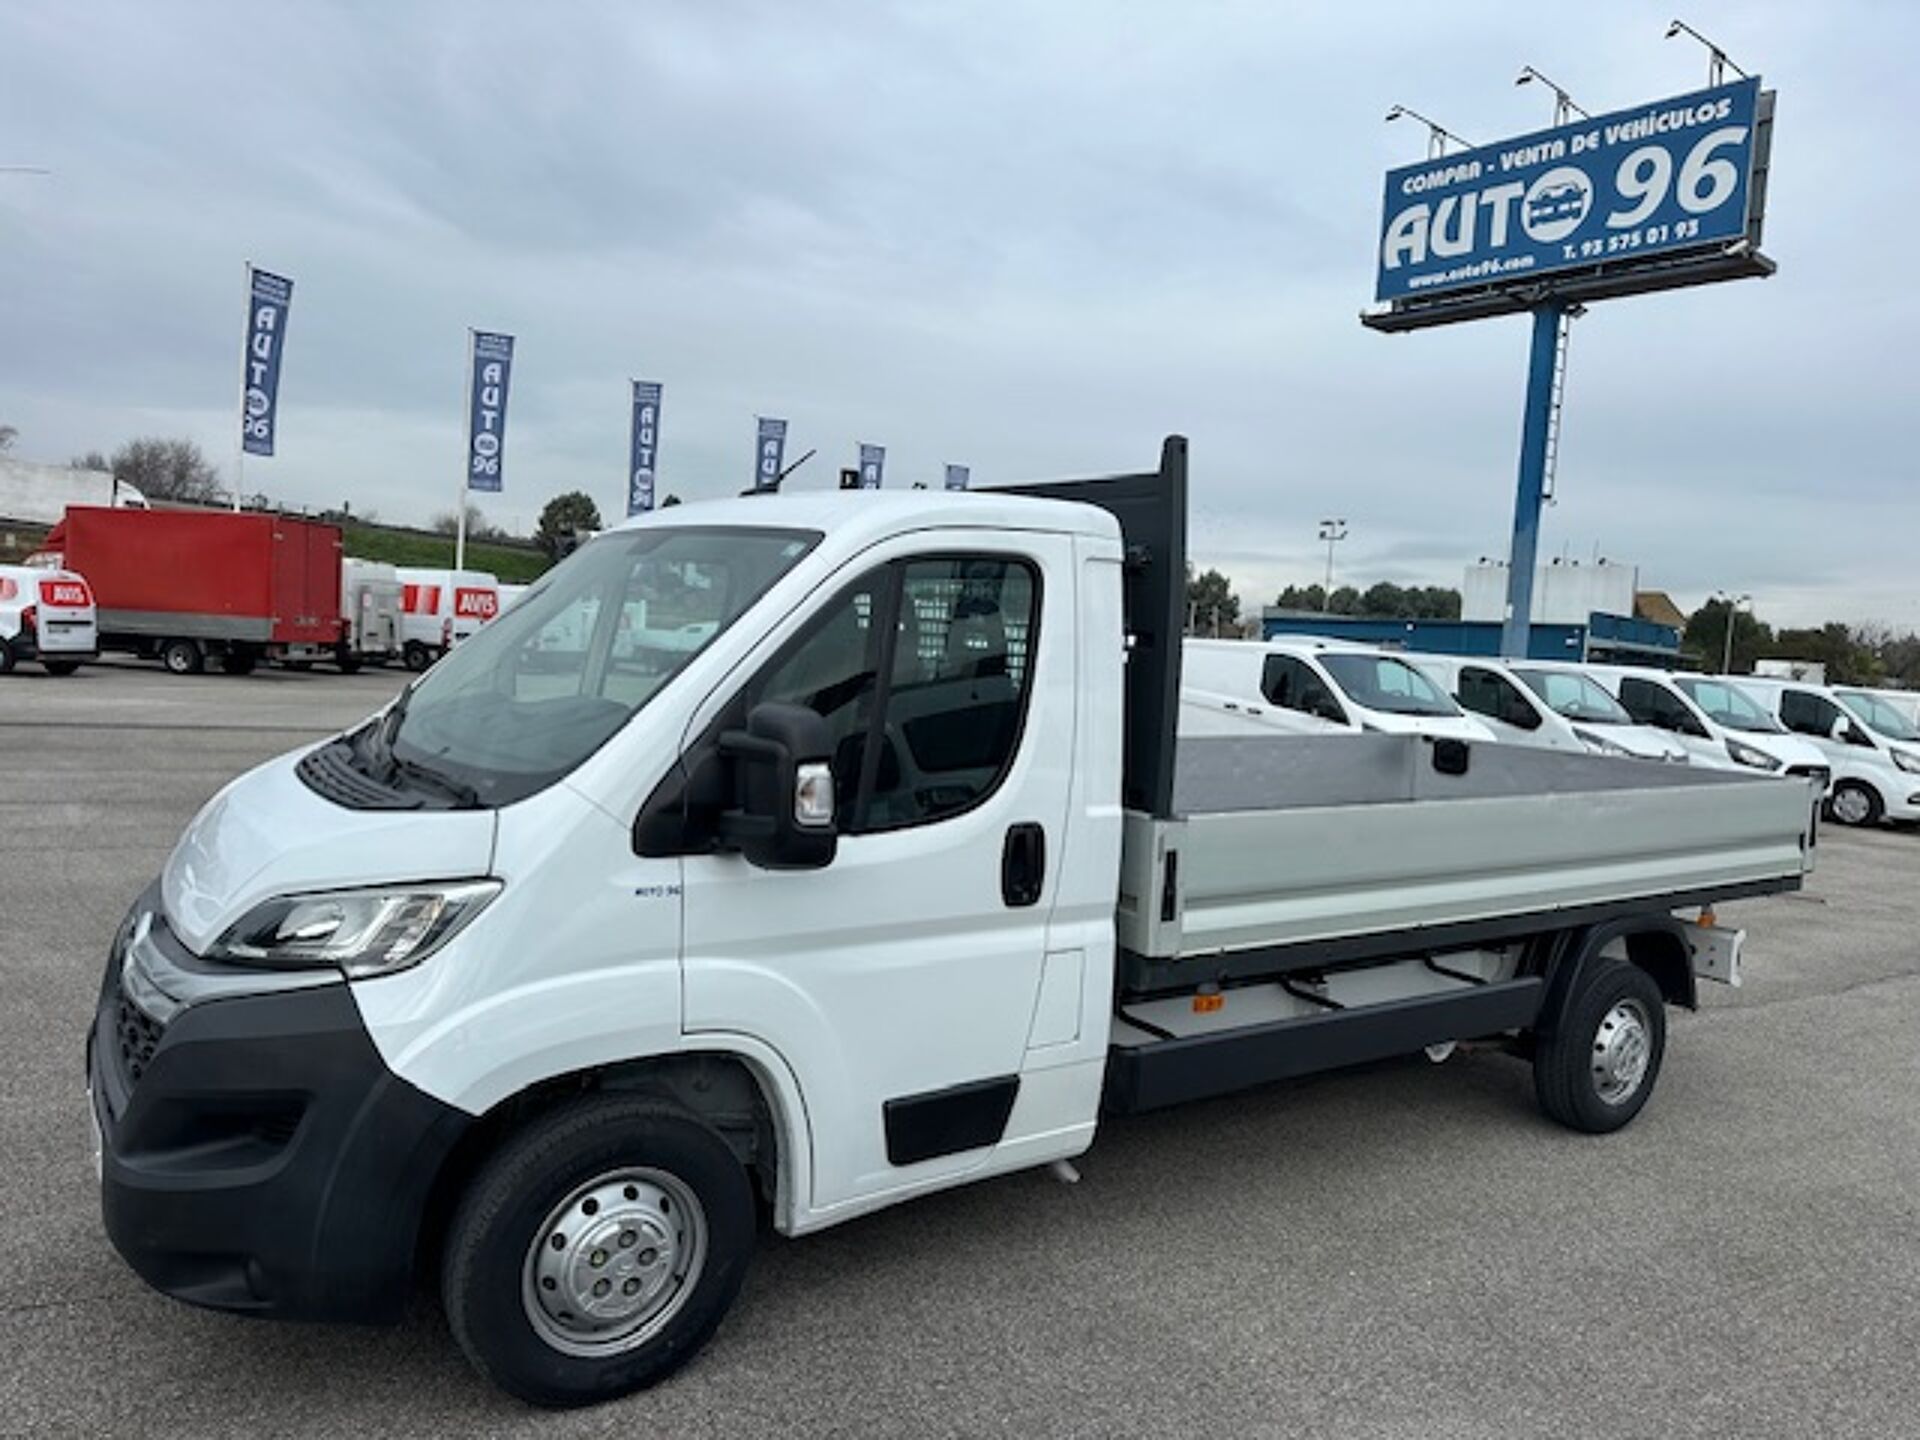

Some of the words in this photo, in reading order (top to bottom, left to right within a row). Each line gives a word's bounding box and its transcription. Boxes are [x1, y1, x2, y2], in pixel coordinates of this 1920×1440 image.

[1402, 161, 1482, 195] COMPRA
[1501, 139, 1566, 172] VENTA
[1571, 131, 1600, 154] DE
[1604, 98, 1733, 145] VEHÍCULOS
[1384, 167, 1594, 269] AUTO
[1605, 126, 1749, 229] 96
[1581, 240, 1603, 256] 93
[1608, 230, 1641, 252] 575
[1646, 224, 1669, 244] 01
[1674, 219, 1699, 239] 93
[1408, 255, 1535, 289] www.auto96.com
[473, 455, 499, 475] 96
[54, 585, 85, 604] AVIS
[459, 593, 496, 614] AVIS
